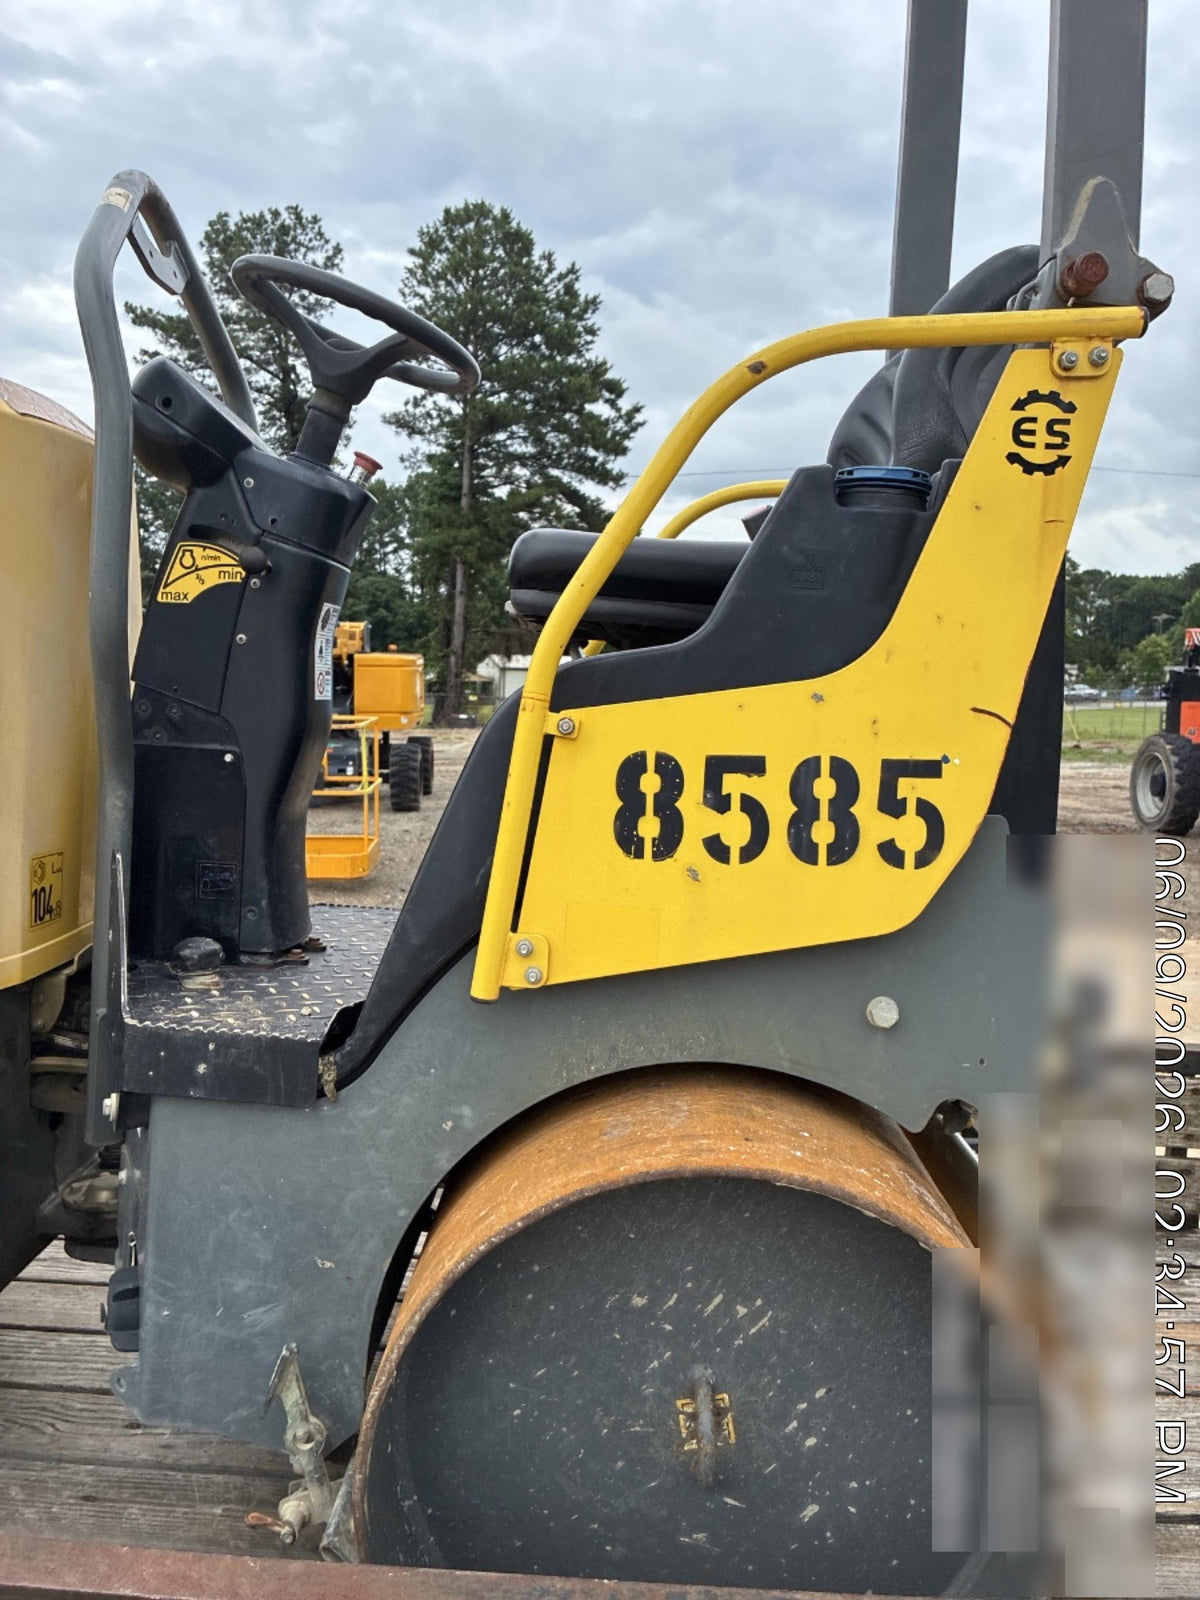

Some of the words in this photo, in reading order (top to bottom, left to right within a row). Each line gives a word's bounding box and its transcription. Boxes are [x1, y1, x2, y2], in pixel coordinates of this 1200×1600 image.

[1011, 416, 1072, 450] ES
[218, 567, 242, 580] min
[160, 591, 190, 601] max
[613, 750, 946, 870] 8585
[32, 883, 53, 924] 104
